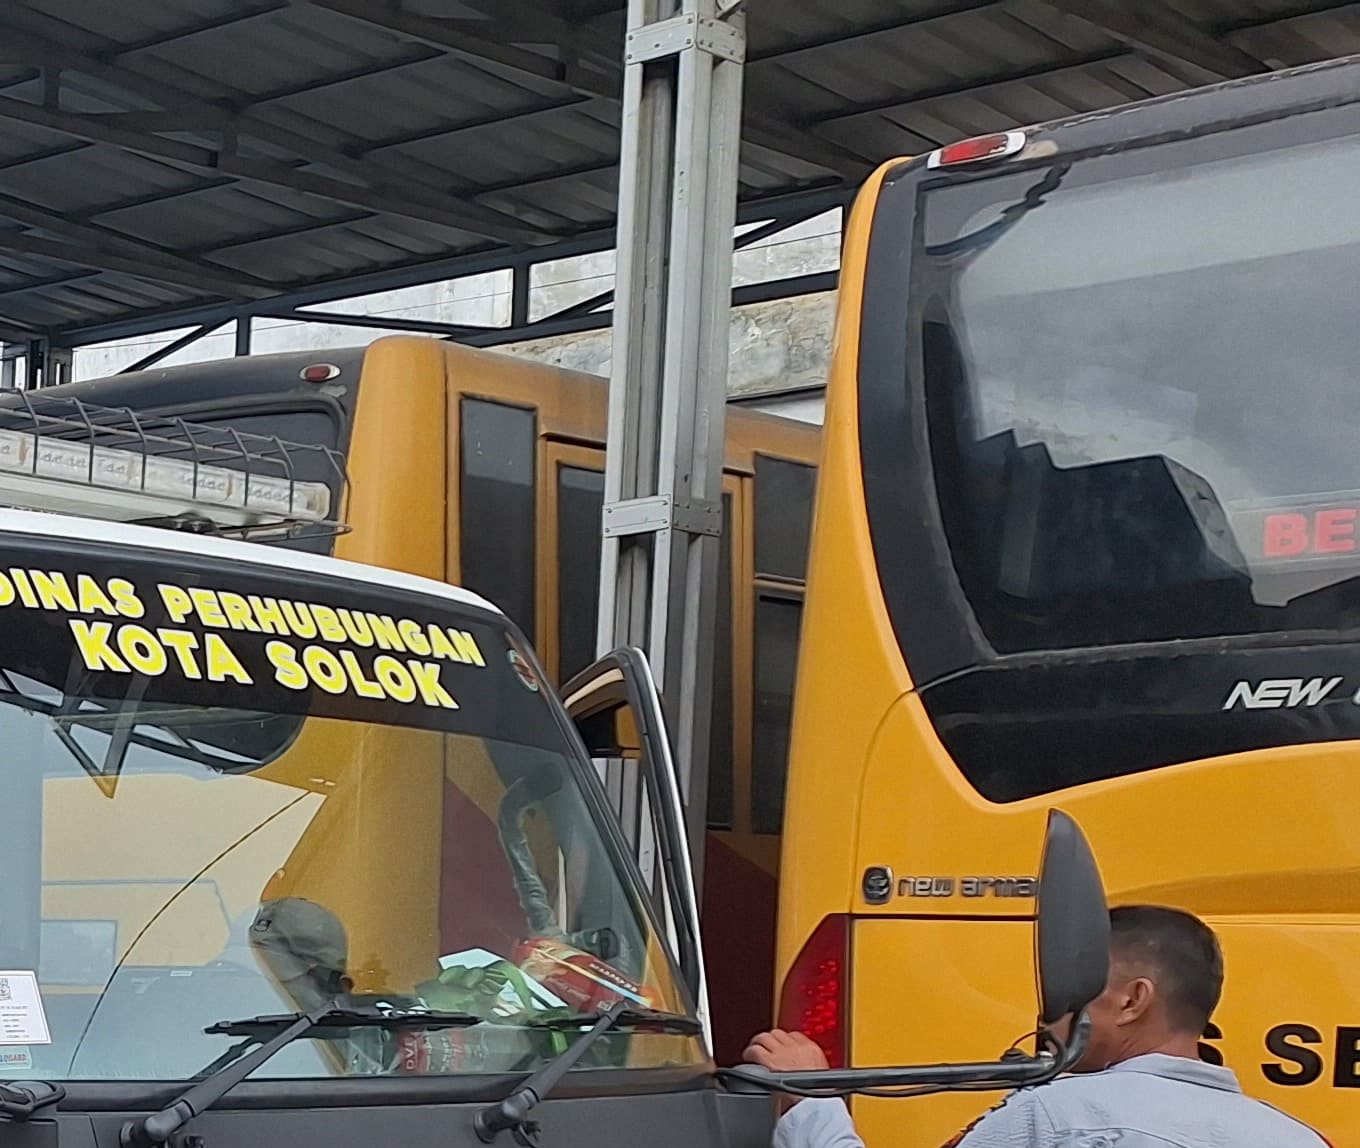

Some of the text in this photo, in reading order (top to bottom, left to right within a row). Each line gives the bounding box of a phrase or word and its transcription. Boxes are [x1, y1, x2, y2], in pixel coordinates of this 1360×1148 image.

[157, 583, 486, 668] PERHUBUNGAN
[68, 619, 461, 710] KOTA SOLOK
[1222, 676, 1344, 710] NEW
[898, 876, 955, 897] new
